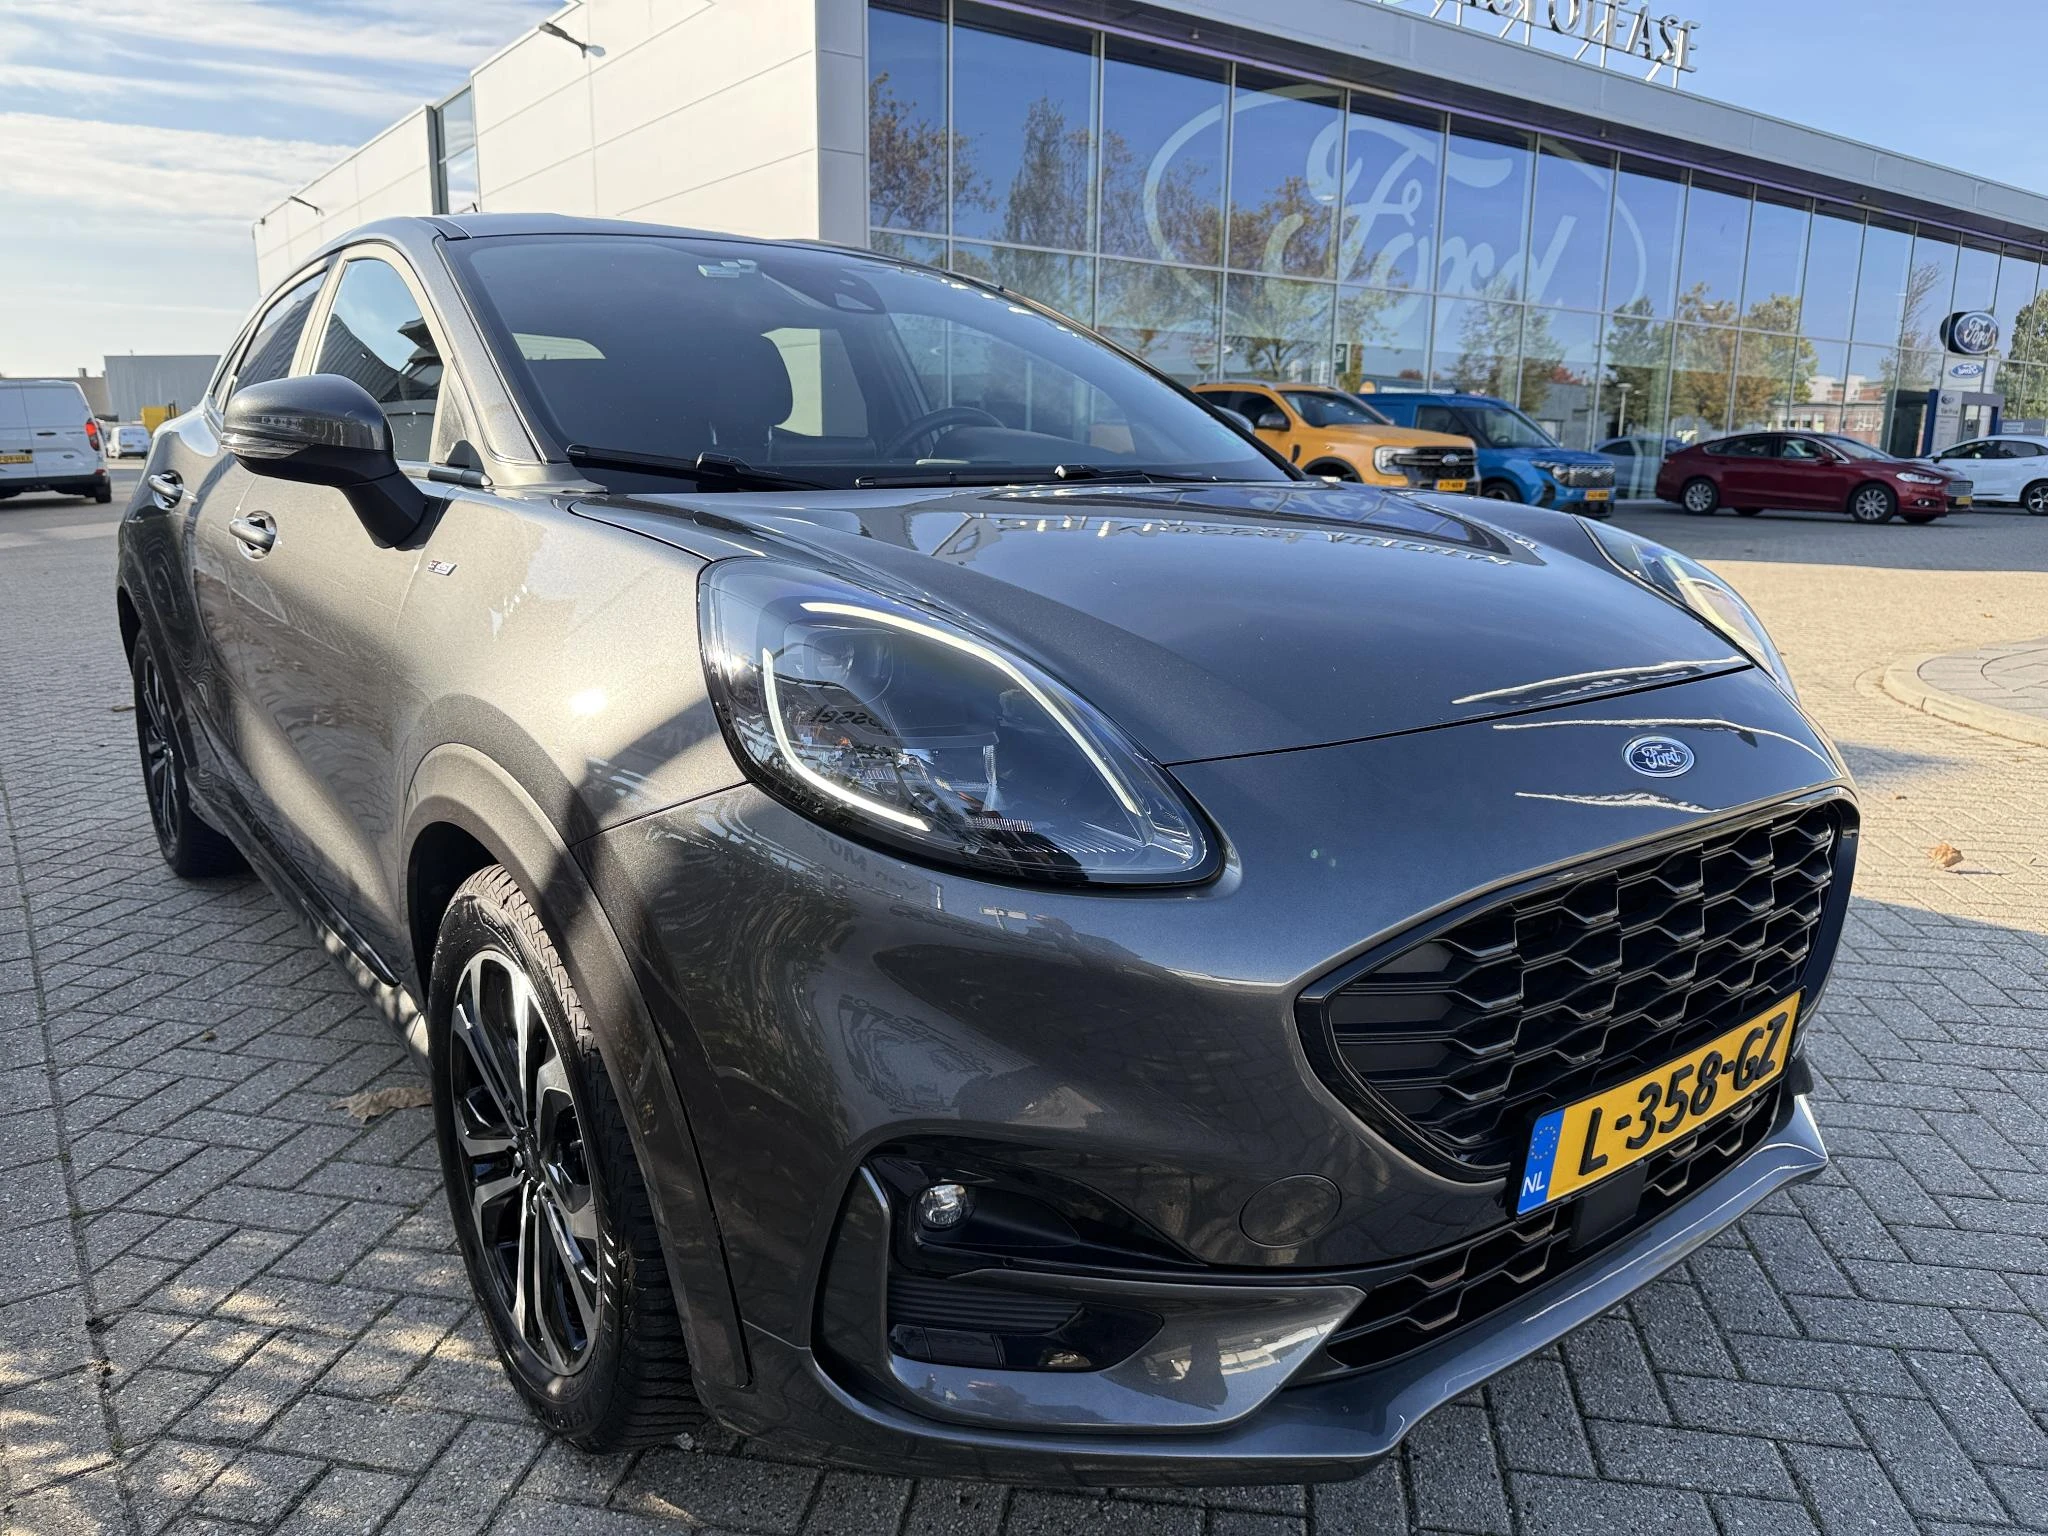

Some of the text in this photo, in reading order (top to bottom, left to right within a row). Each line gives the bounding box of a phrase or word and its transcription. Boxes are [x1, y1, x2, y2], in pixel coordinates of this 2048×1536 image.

[1262, 114, 1577, 336] Ford
[1963, 317, 1994, 348] Ford
[1641, 744, 1681, 769] Ford
[1578, 1011, 1788, 1176] L-358-GZ
[1521, 1171, 1546, 1197] NL
